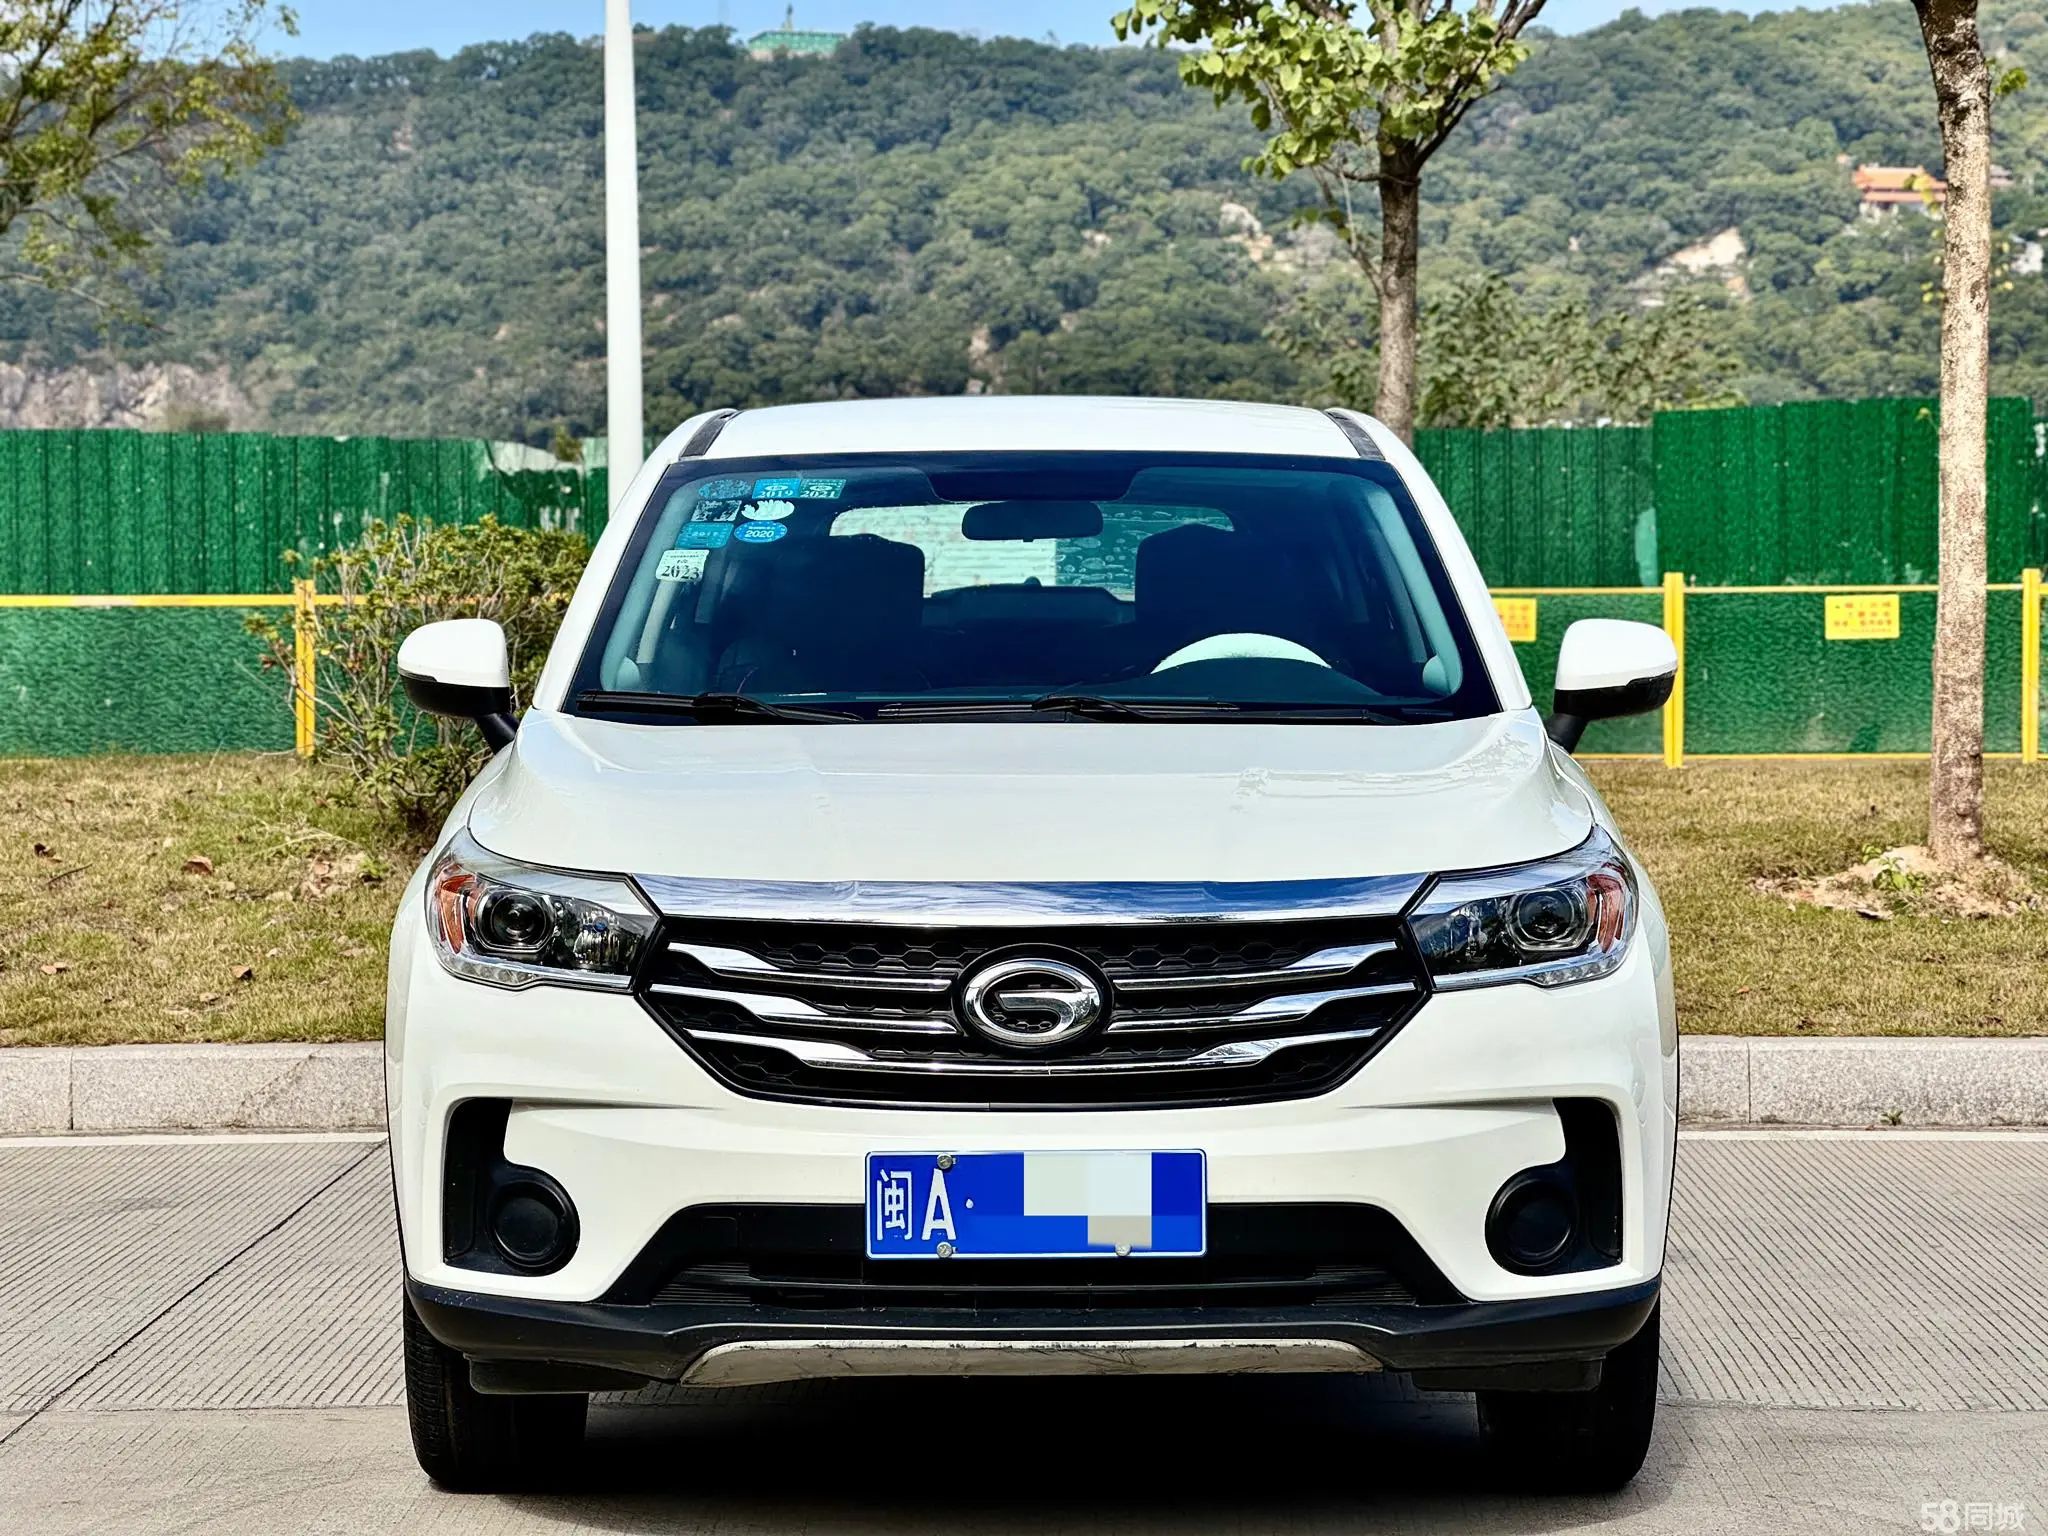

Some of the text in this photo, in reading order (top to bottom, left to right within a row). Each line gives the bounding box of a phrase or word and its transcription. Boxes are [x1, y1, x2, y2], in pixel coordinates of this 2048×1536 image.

[759, 490, 794, 498] 2019
[800, 490, 836, 498] 2021
[744, 530, 775, 538] 2020
[661, 565, 700, 580] 2023
